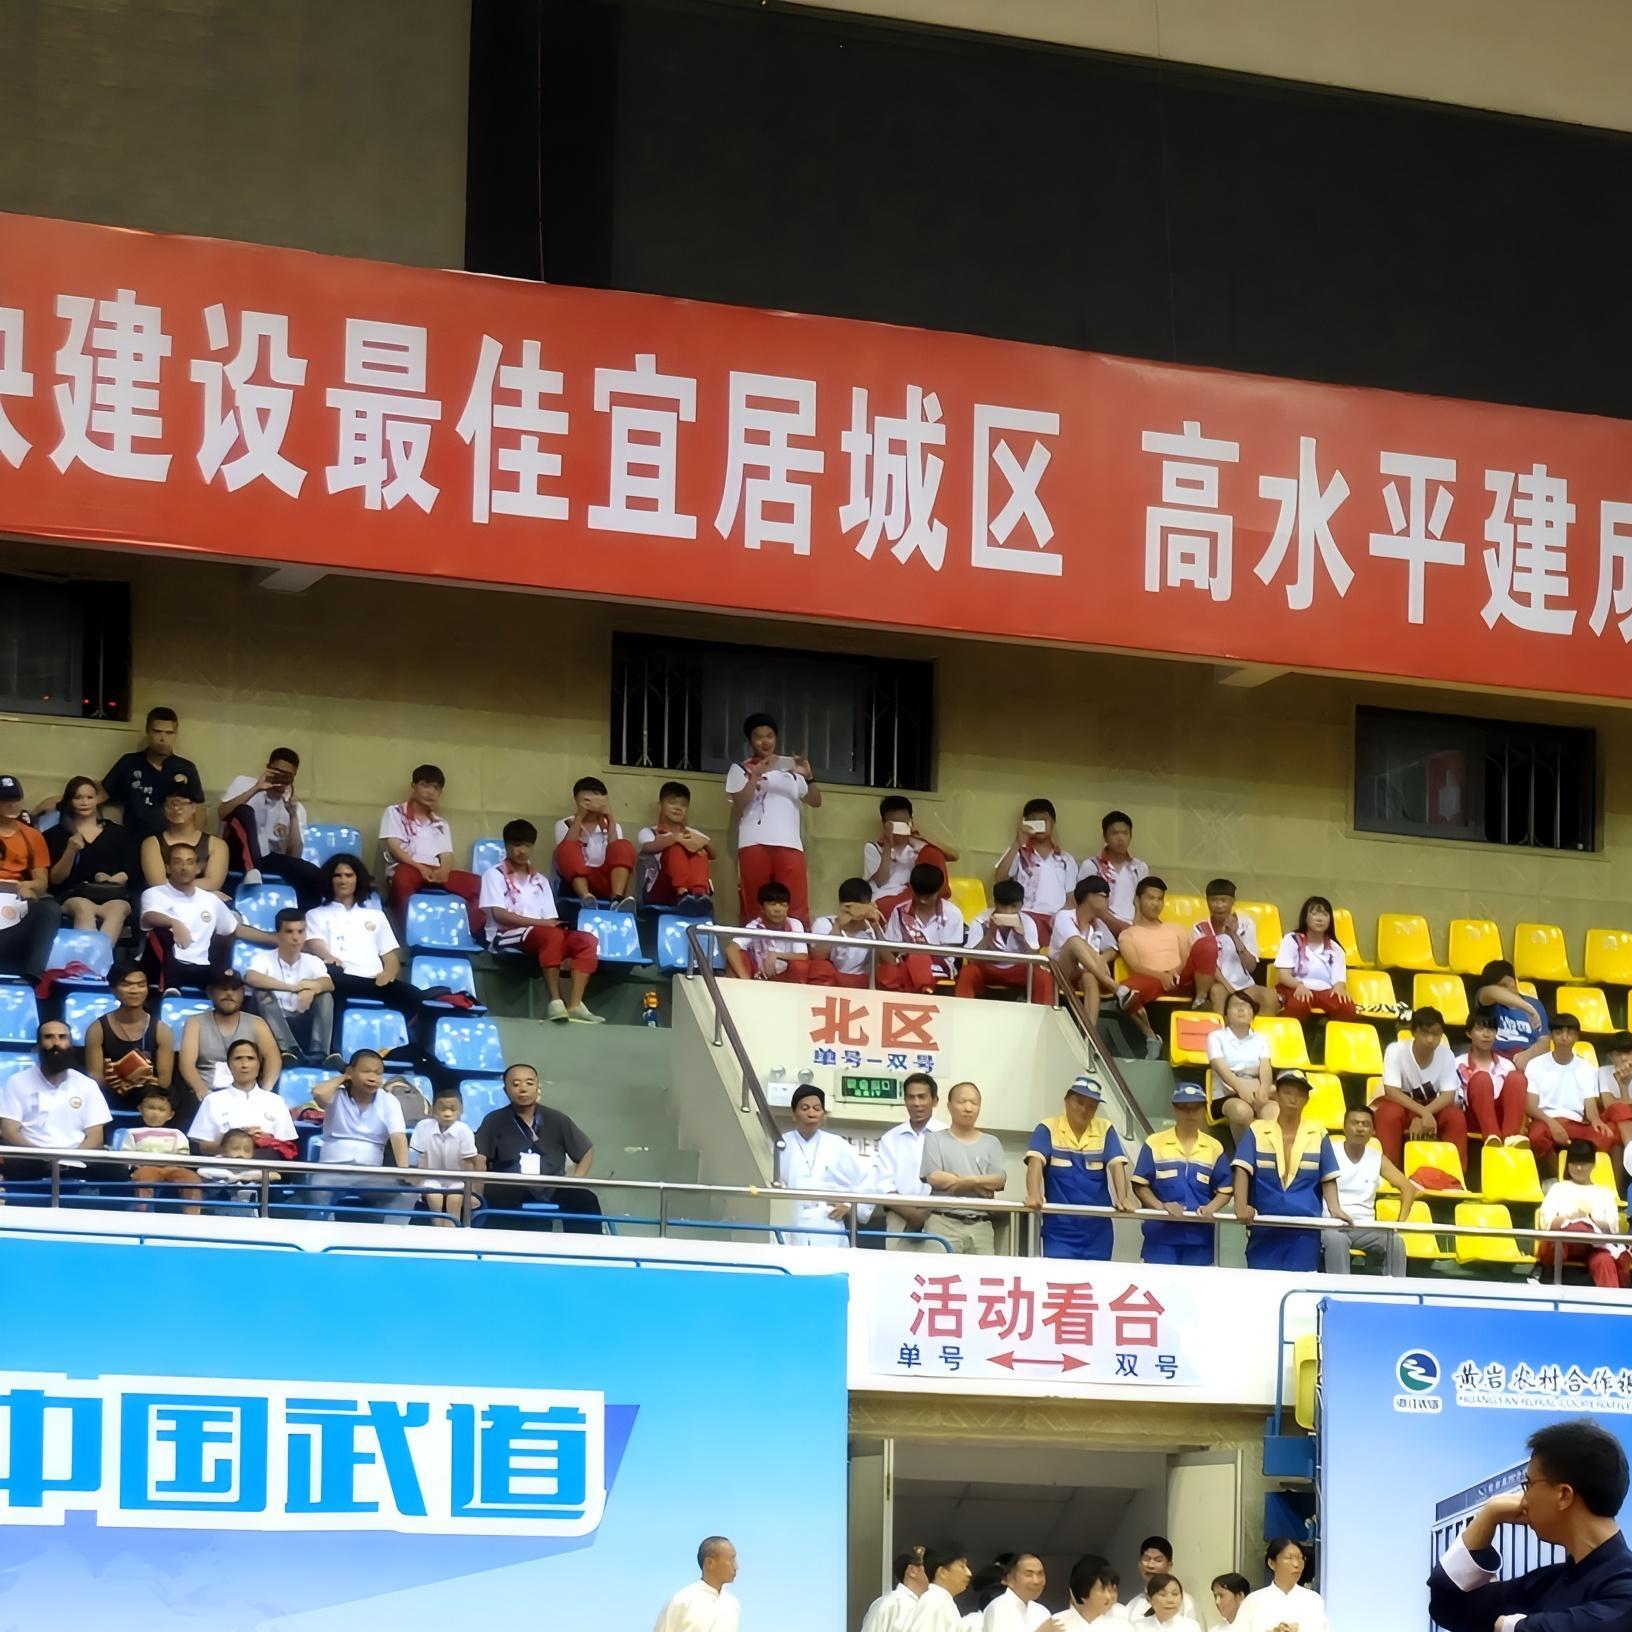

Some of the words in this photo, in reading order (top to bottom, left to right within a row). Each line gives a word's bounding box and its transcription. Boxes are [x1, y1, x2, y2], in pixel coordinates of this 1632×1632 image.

[809, 995, 940, 1051] 北区
[909, 1274, 1166, 1348] 活动看台
[897, 1342, 964, 1371] 单号
[1114, 1352, 1179, 1379] 双号
[0, 1387, 589, 1519] 中国武道
